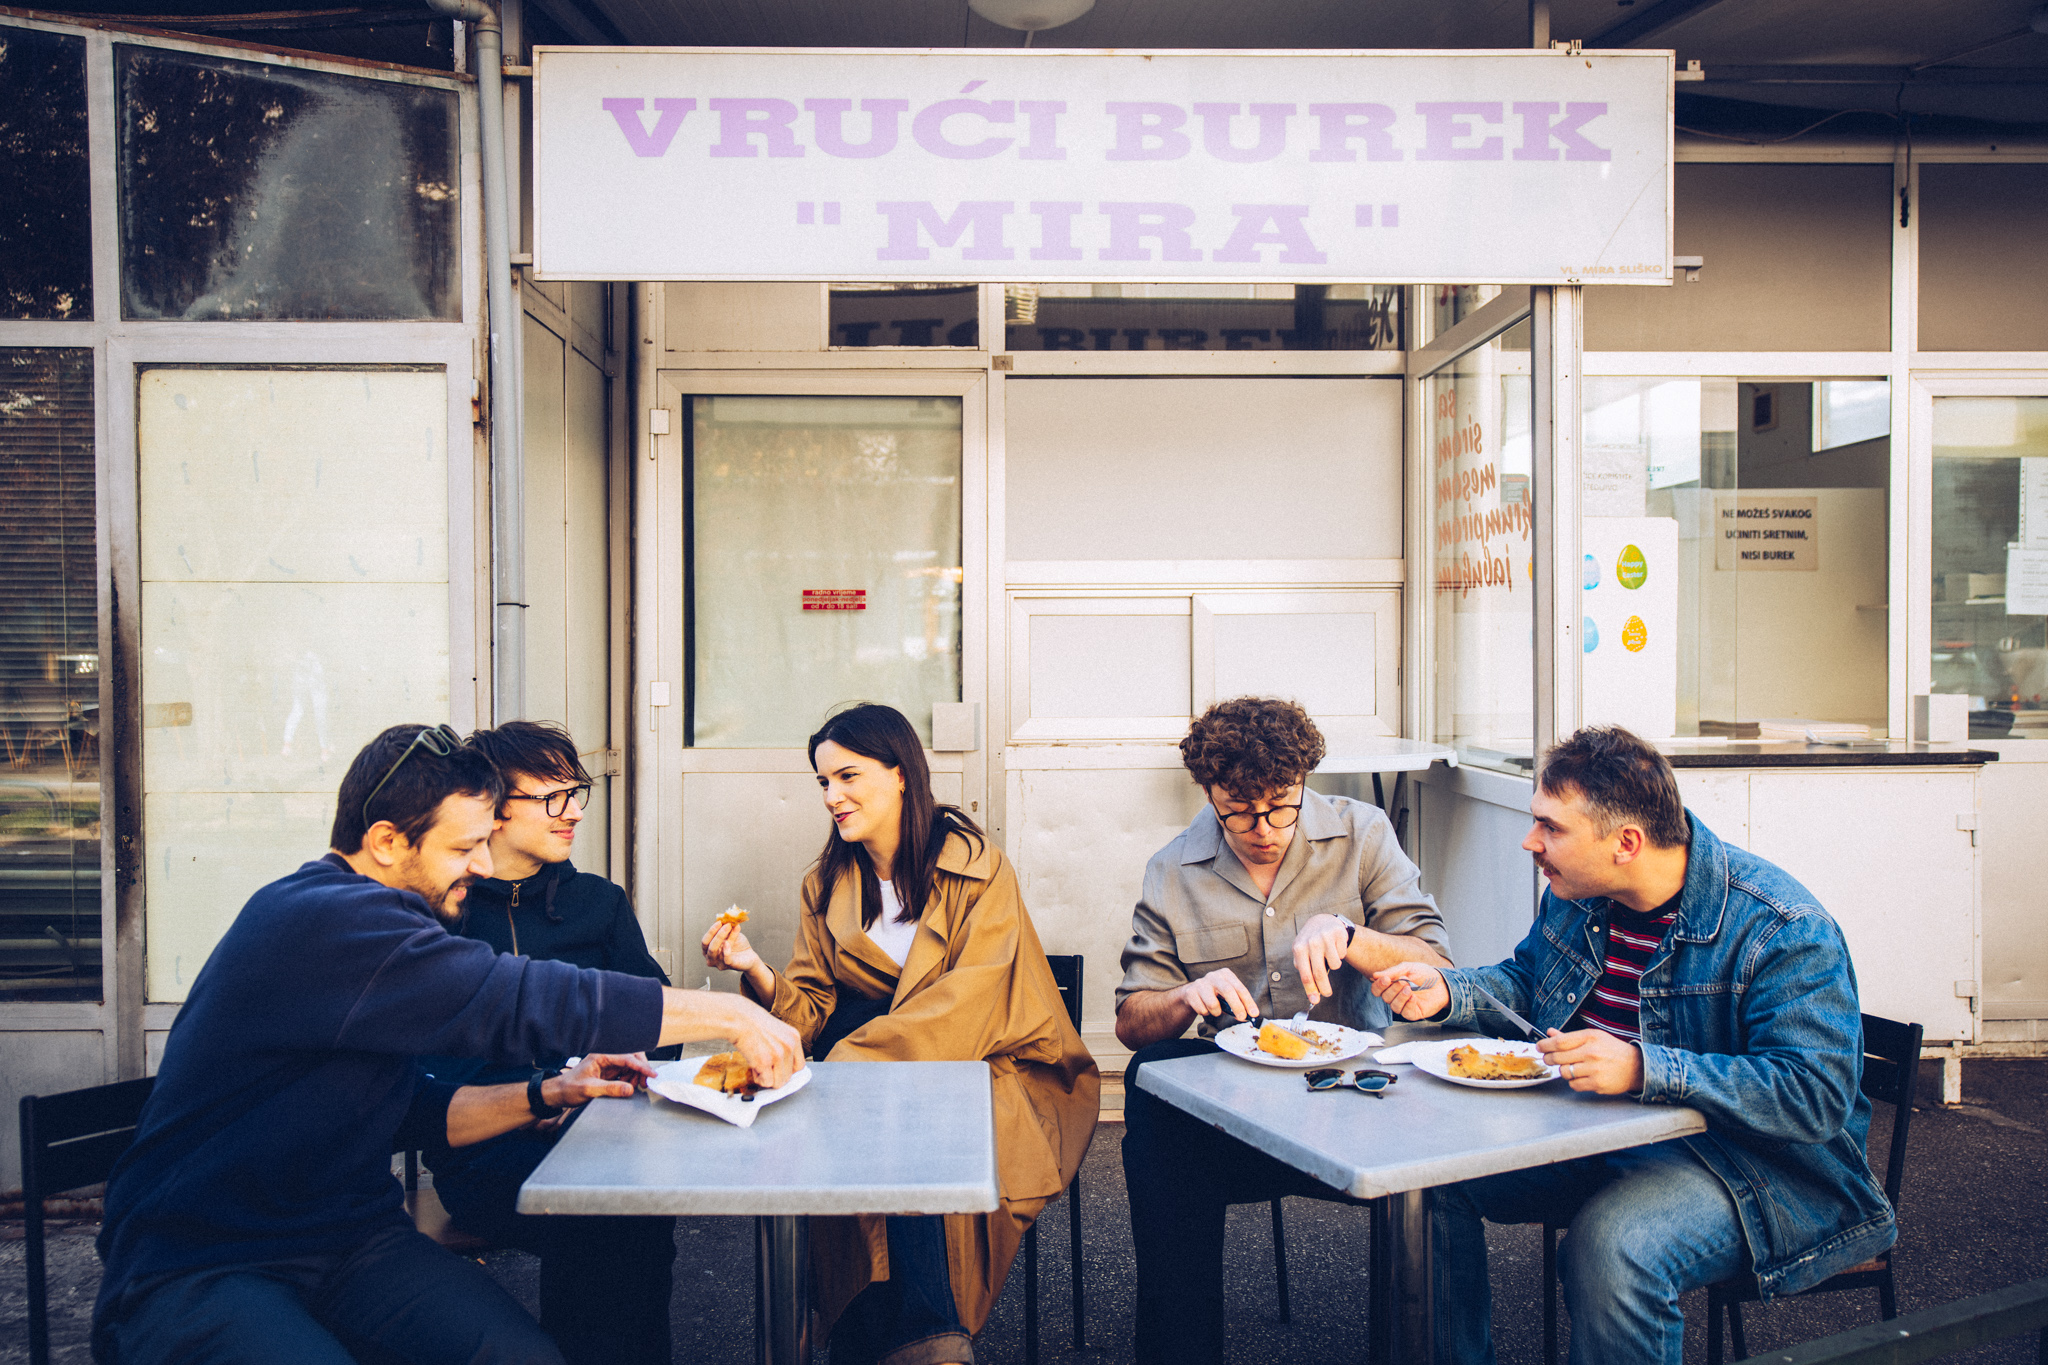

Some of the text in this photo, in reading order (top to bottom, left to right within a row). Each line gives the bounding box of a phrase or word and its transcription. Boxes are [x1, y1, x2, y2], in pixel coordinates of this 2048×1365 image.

[602, 80, 1612, 163] VRUĆI BUREK
[1582, 265, 1615, 275] MIRA
[1619, 262, 1663, 274] SLIŠKO
[1722, 507, 1812, 519] NE MOŽEŠ SVAKOG
[1763, 529, 1809, 541] SRETNIM,
[1741, 551, 1796, 560] NISI BUREK
